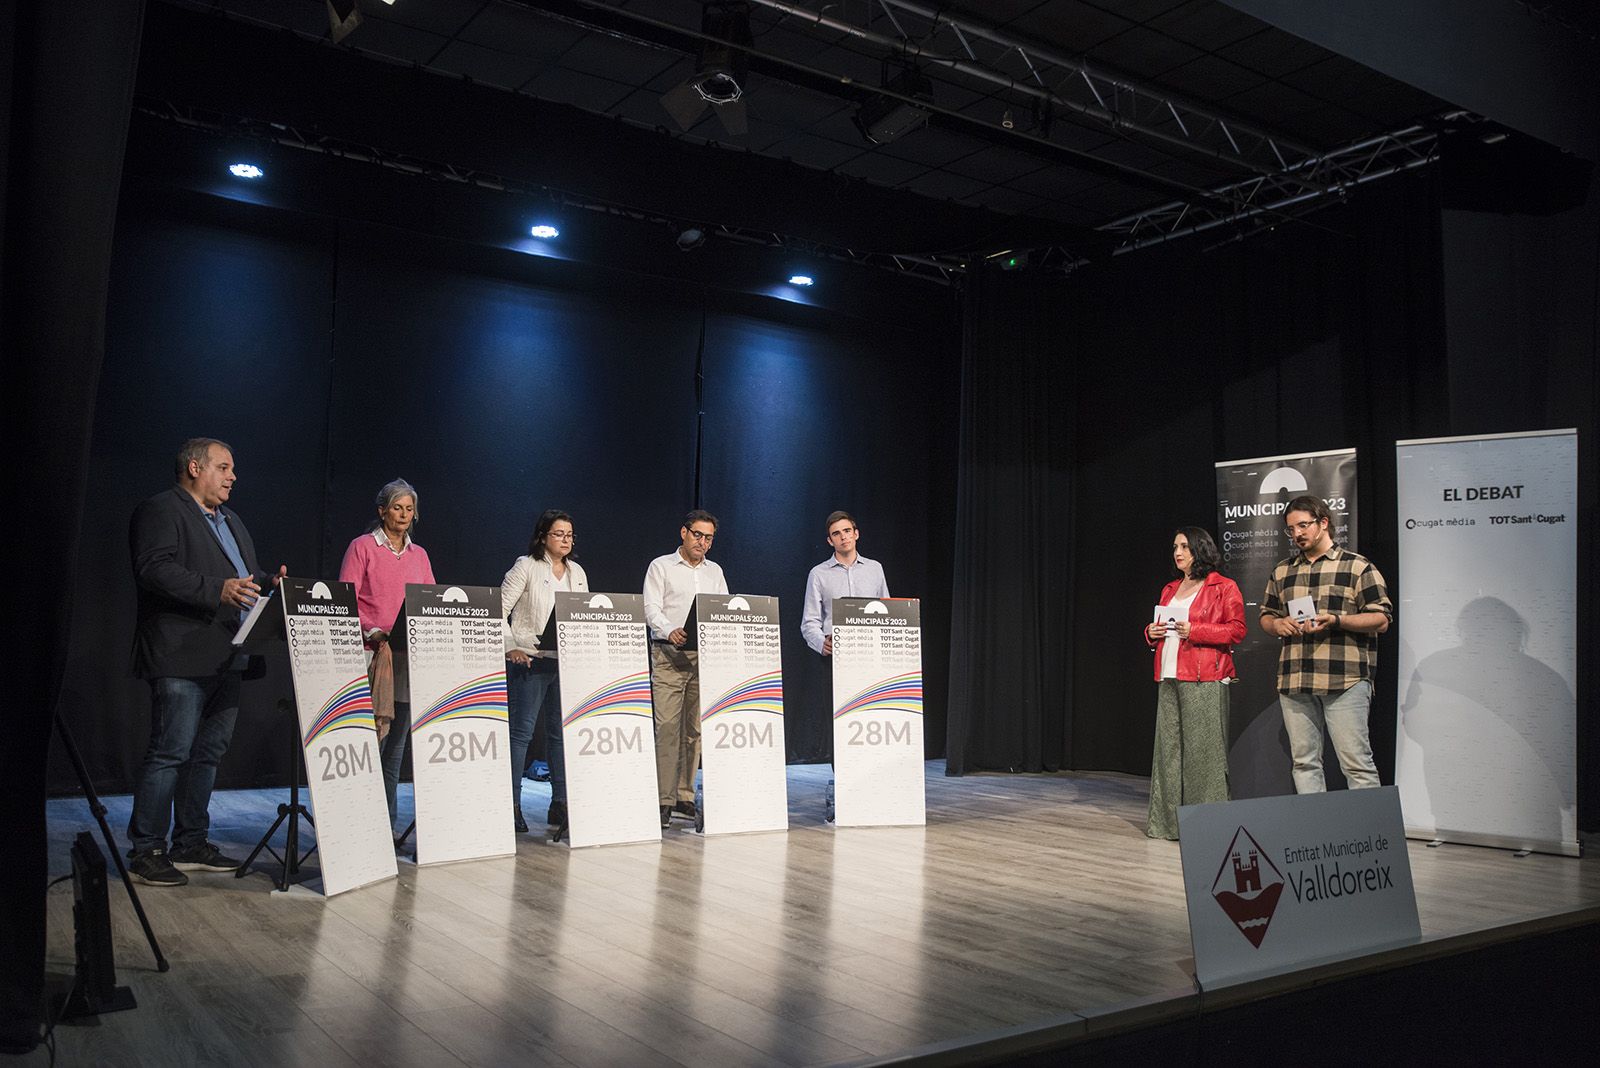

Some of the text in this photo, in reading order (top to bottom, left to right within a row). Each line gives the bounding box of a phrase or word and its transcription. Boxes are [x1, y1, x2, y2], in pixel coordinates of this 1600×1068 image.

[1443, 485, 1524, 501] EL DEBAT
[1322, 497, 1346, 511] 23
[1416, 518, 1476, 529] cugat mèdia
[1489, 514, 1566, 525] TOT Sant Cugat
[1232, 529, 1253, 539] cugat
[297, 604, 349, 615] MUNICIPALS 2023
[422, 606, 489, 616] MUNICIPALS 2023
[615, 613, 632, 621] 2023
[710, 614, 752, 622] MUNICIPALS
[845, 617, 889, 625] MUNICIPALS
[714, 722, 773, 750] 28M
[847, 720, 911, 746] 28M
[428, 731, 497, 764] 28M
[578, 726, 643, 757] 28M
[319, 741, 373, 781] 28M
[1284, 834, 1389, 864] Entitat Municipal de
[1287, 859, 1394, 904] Valldoreix
